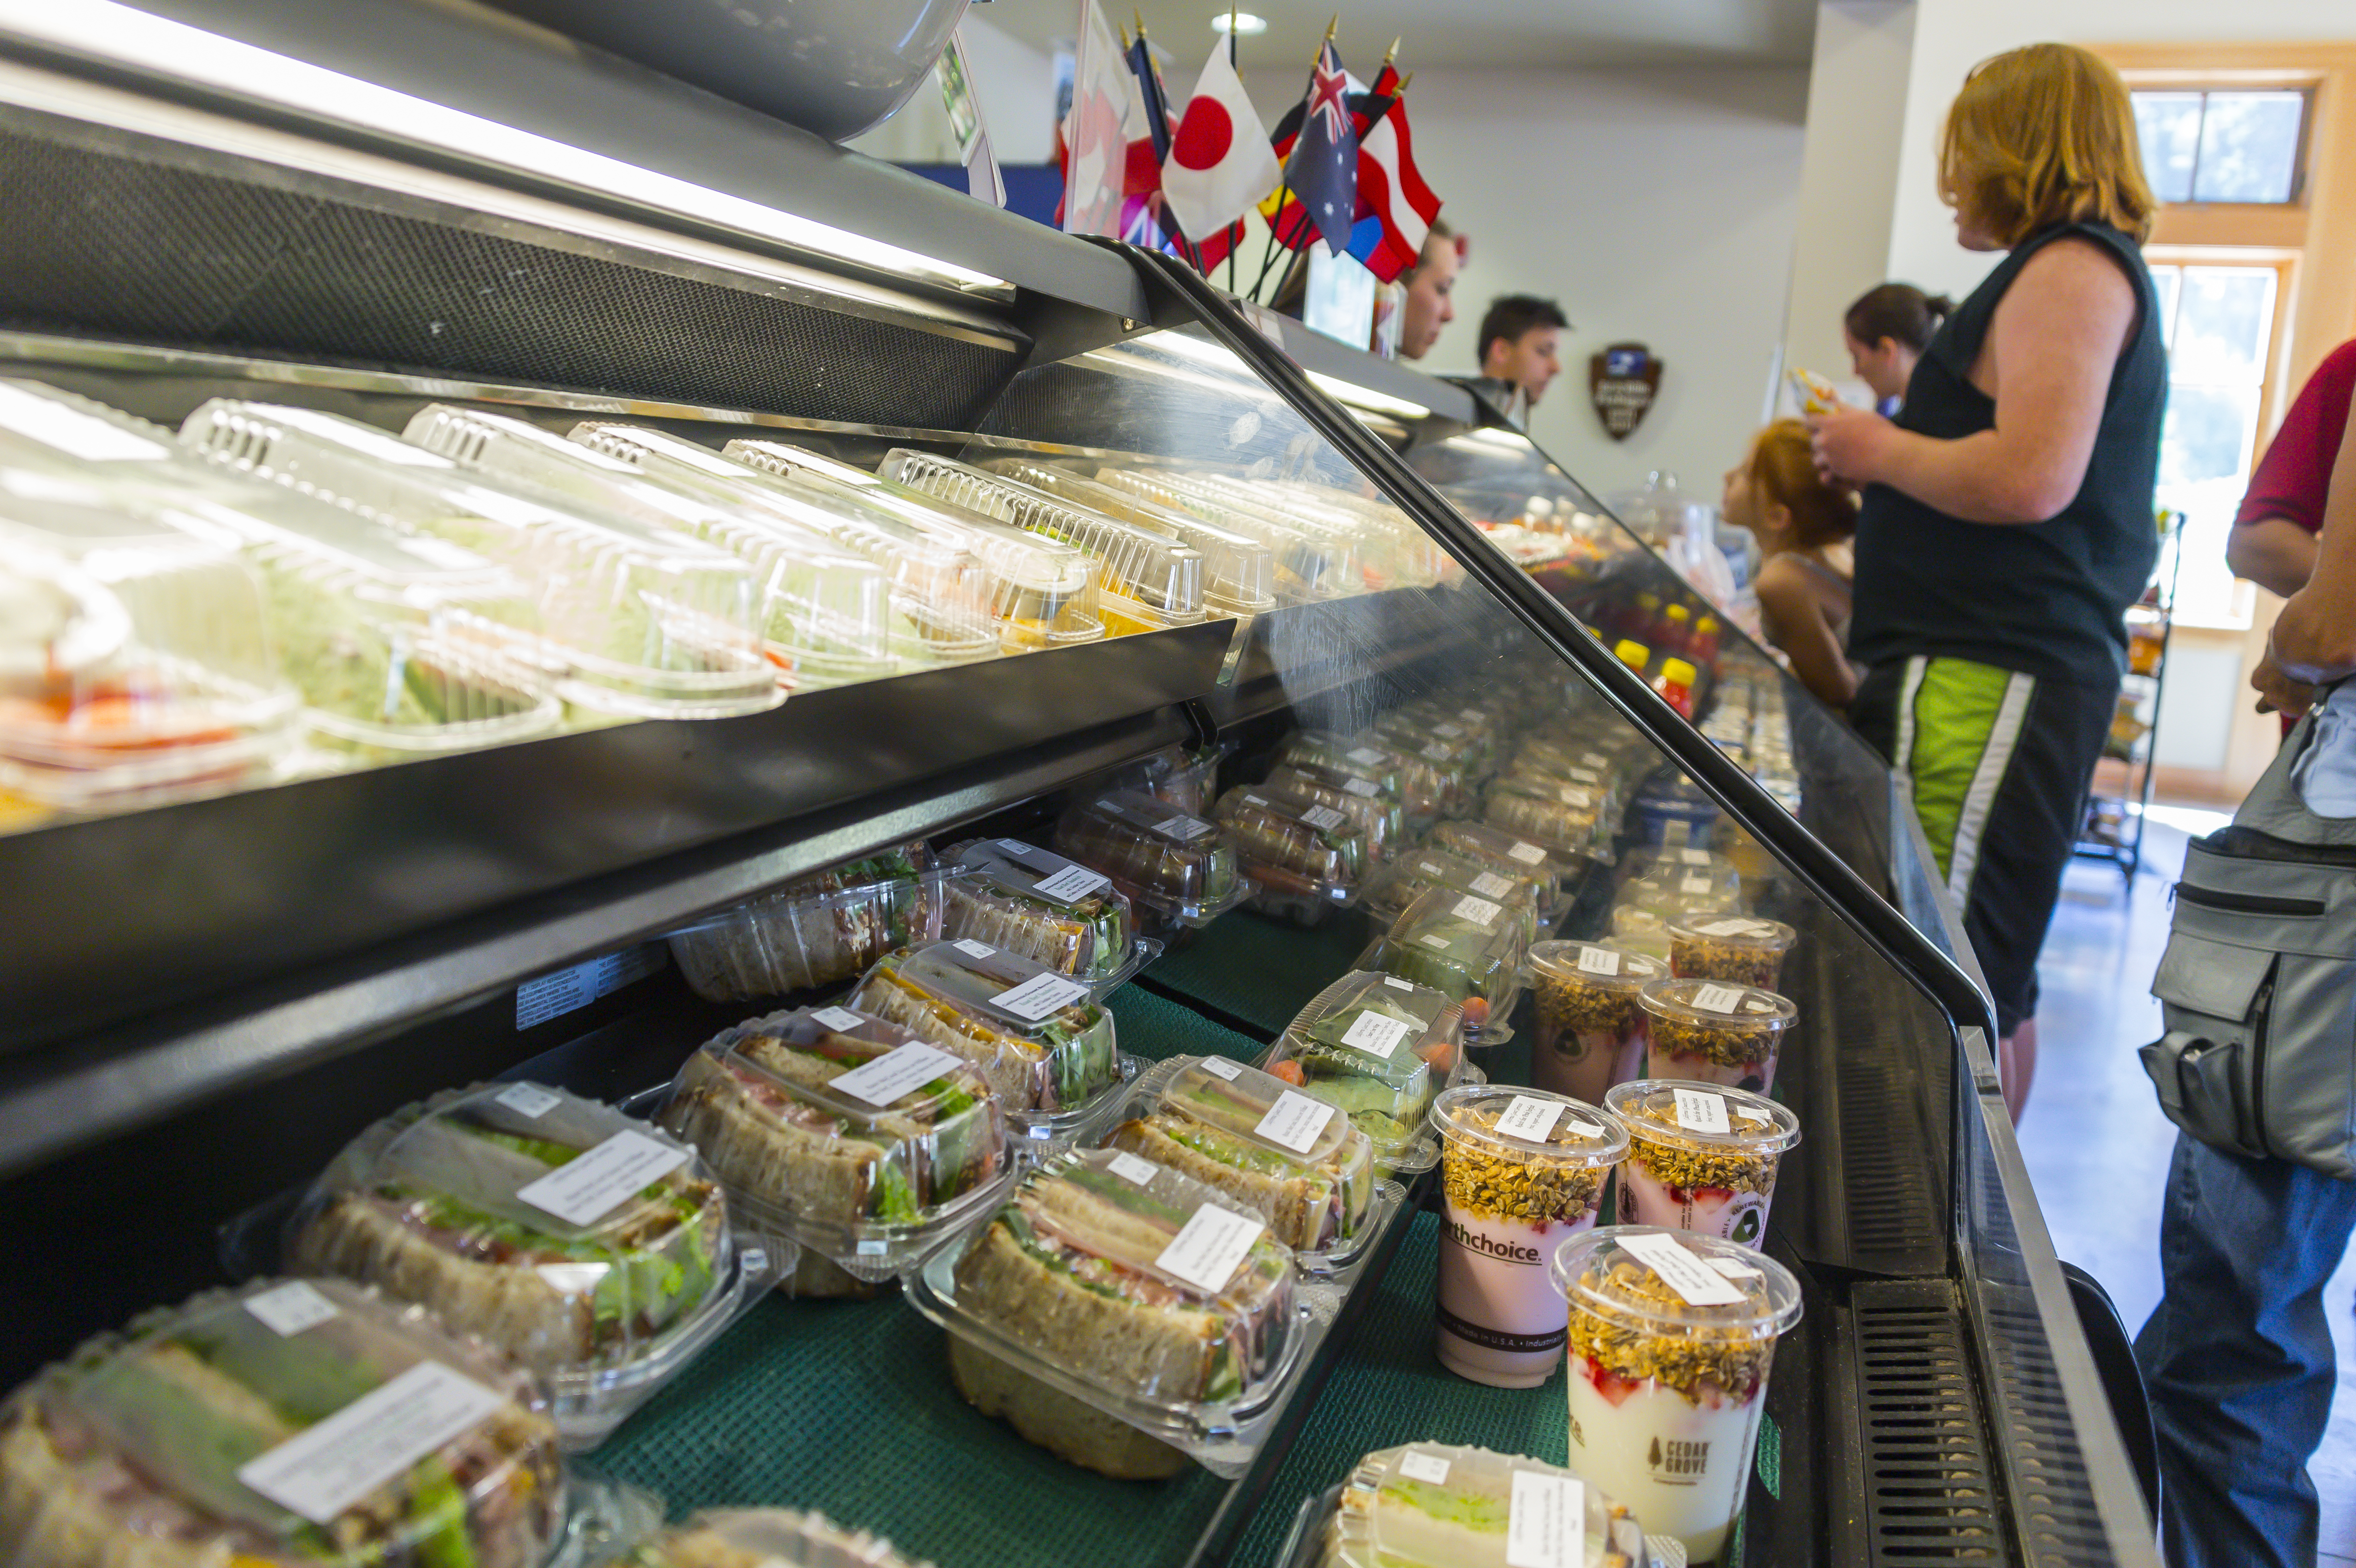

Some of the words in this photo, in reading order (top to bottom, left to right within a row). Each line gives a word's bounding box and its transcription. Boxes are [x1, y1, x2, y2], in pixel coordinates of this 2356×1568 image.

[1457, 1325, 1478, 1338] Made
[1667, 1440, 1709, 1457] CEDAR
[1666, 1457, 1706, 1474] GROVE
